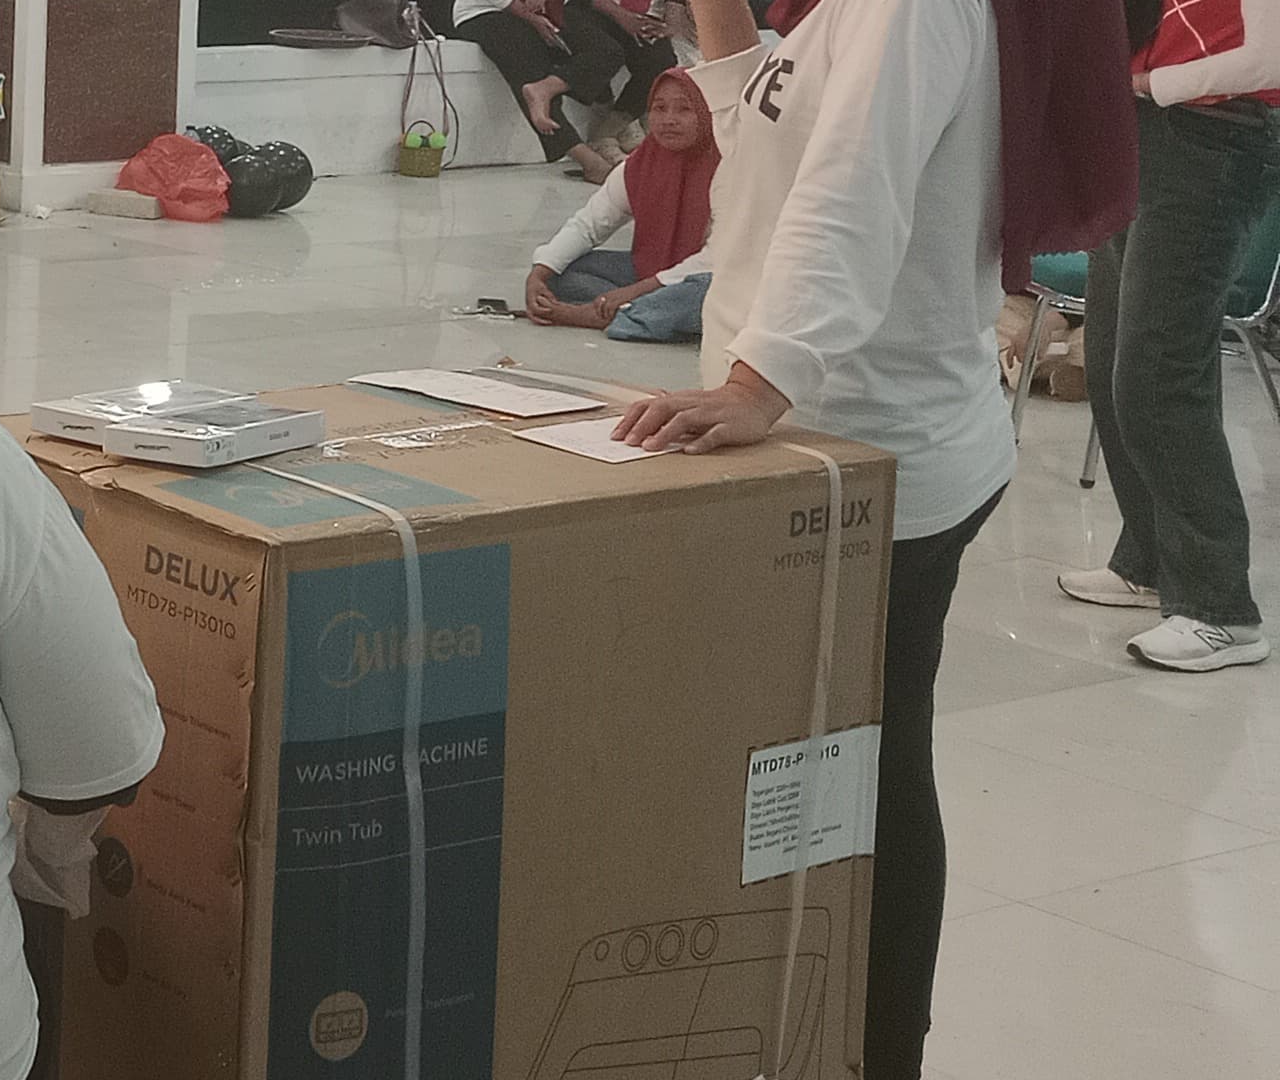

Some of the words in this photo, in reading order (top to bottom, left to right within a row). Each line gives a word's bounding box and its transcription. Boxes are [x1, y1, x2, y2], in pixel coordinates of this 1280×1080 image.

[144, 543, 241, 607] DELUX
[127, 584, 237, 641] MTD78-P1301Q
[296, 754, 396, 793] WASHING
[406, 737, 489, 770] ACHINE
[292, 825, 341, 847] Twin
[349, 819, 383, 841] Tub
